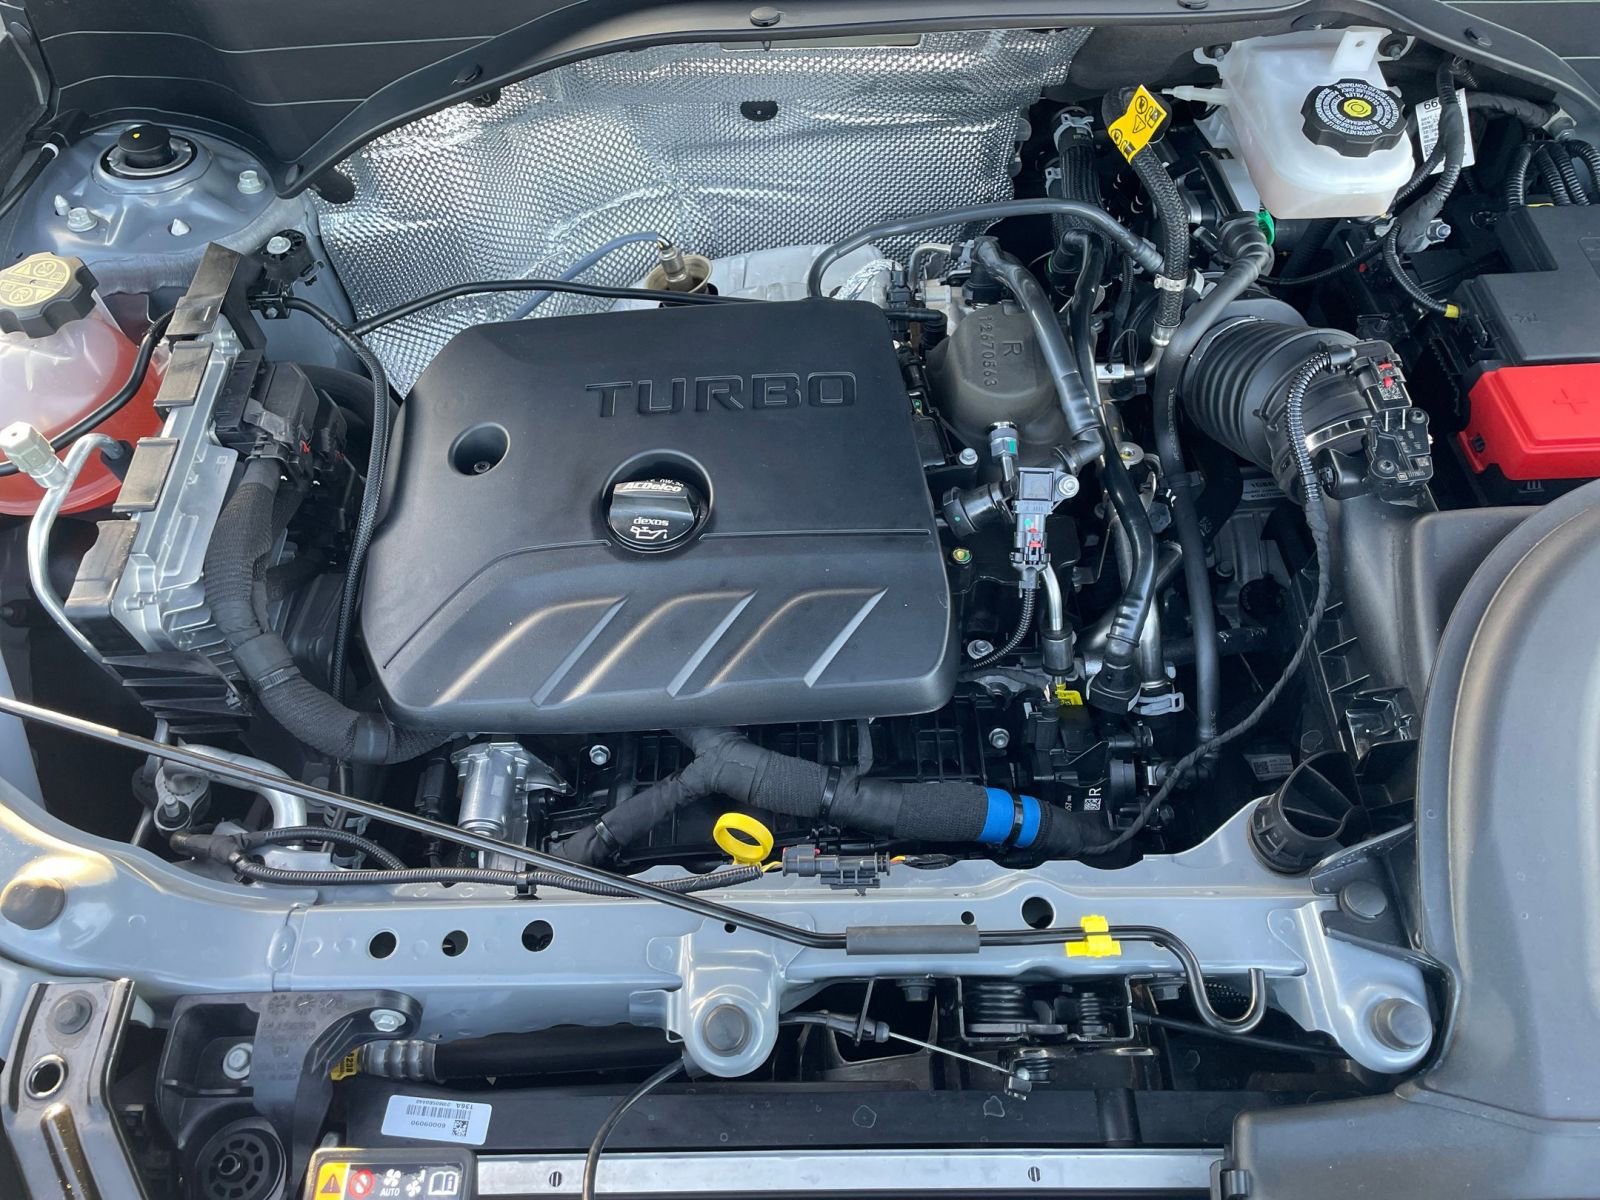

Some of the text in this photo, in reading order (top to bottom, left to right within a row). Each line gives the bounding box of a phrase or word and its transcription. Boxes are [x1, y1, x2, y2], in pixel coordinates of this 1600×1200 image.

[1002, 340, 1024, 357] R
[585, 371, 858, 418] TURBO
[623, 482, 682, 492] ACDelco
[633, 516, 669, 526] dexos
[1088, 787, 1102, 797] R
[380, 1187, 400, 1197] AUTO
